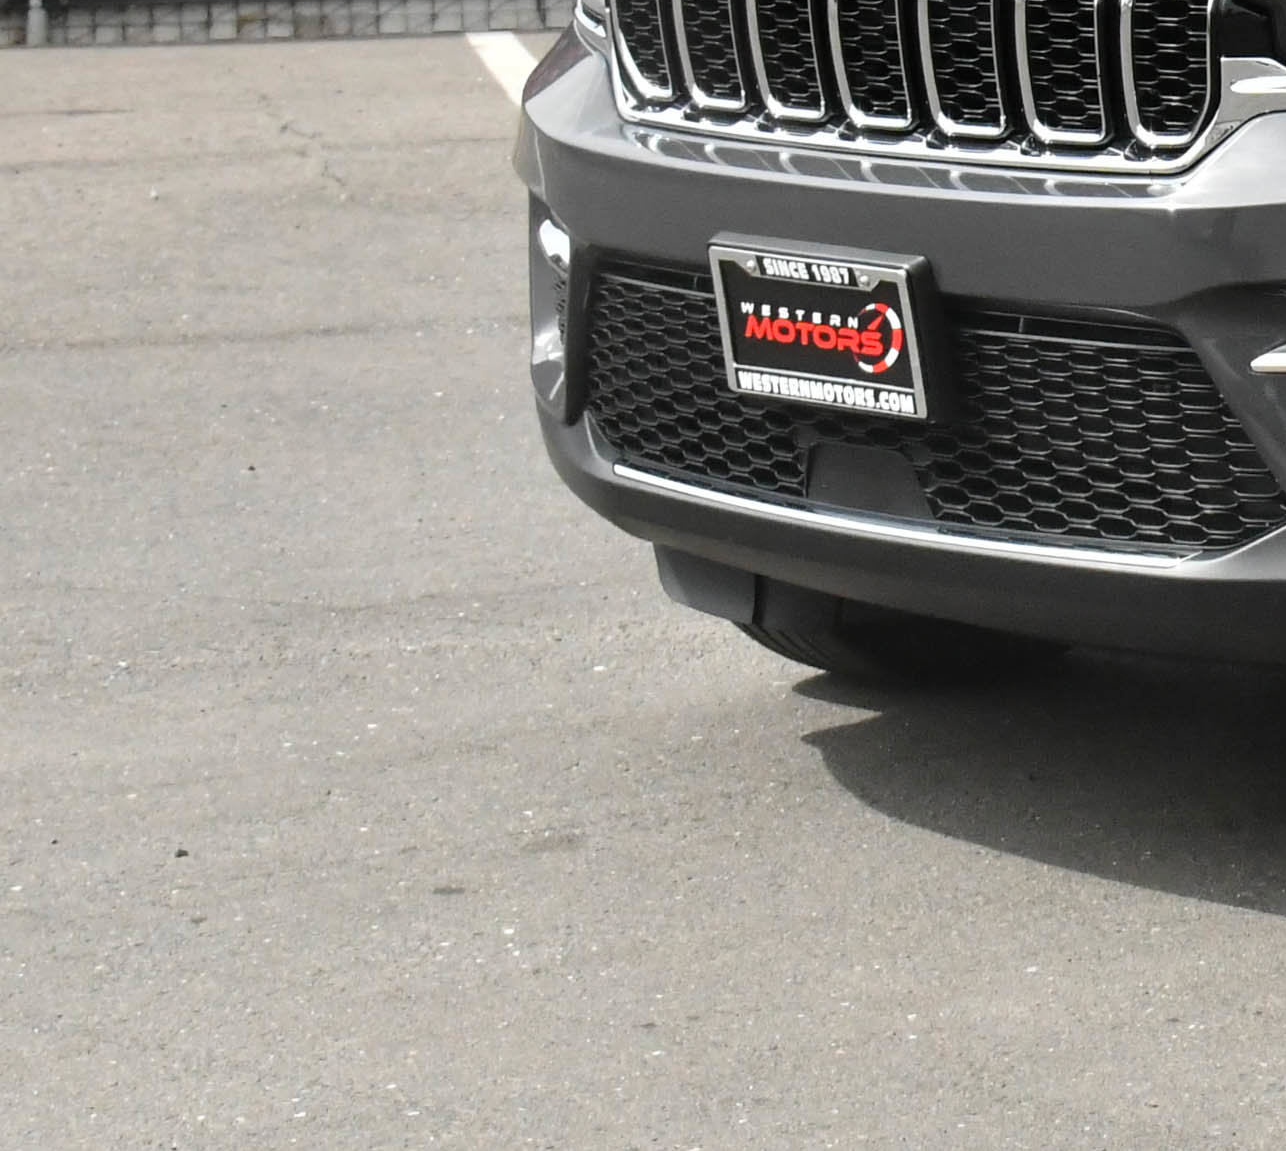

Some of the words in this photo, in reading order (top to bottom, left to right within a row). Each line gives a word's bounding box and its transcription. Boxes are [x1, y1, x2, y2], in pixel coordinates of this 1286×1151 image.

[762, 257, 810, 280] SINCE
[811, 265, 850, 284] 1987
[740, 302, 859, 329] WESTERN
[744, 315, 884, 356] MOTORS
[738, 370, 915, 414] WESTERNMOTORS.COM
